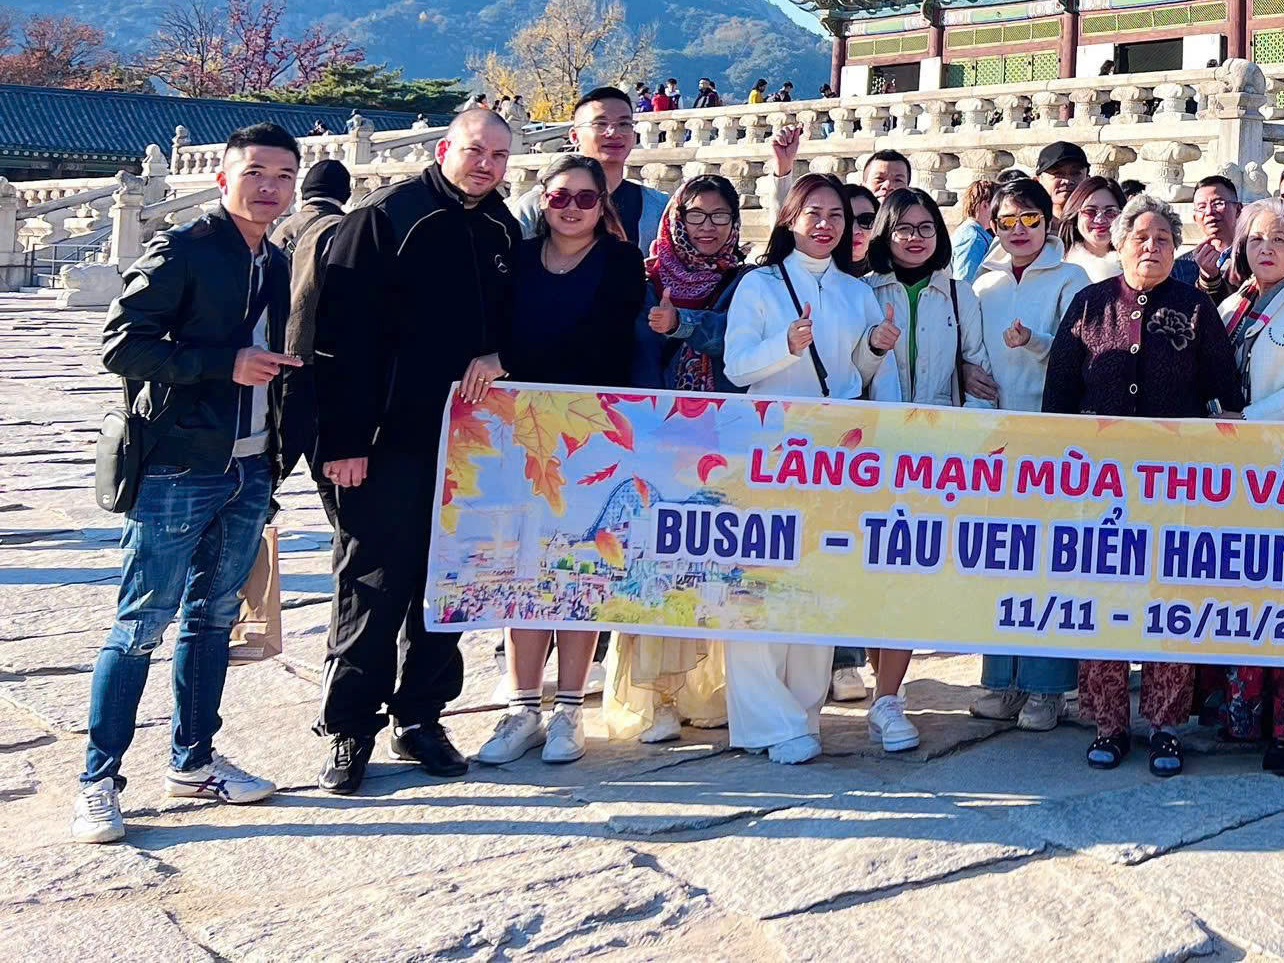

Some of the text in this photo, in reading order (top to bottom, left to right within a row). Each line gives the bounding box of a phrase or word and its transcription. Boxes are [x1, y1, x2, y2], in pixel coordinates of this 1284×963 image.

[751, 438, 880, 487] LÃNG
[895, 456, 1002, 501] MẠN
[1018, 450, 1122, 497] MÙA
[1136, 464, 1232, 502] THU
[655, 508, 797, 561] BUSAN
[865, 507, 943, 567] TÀU
[958, 521, 1037, 571] VEN
[1051, 506, 1148, 576] BIỂN
[998, 596, 1095, 631] 11/11
